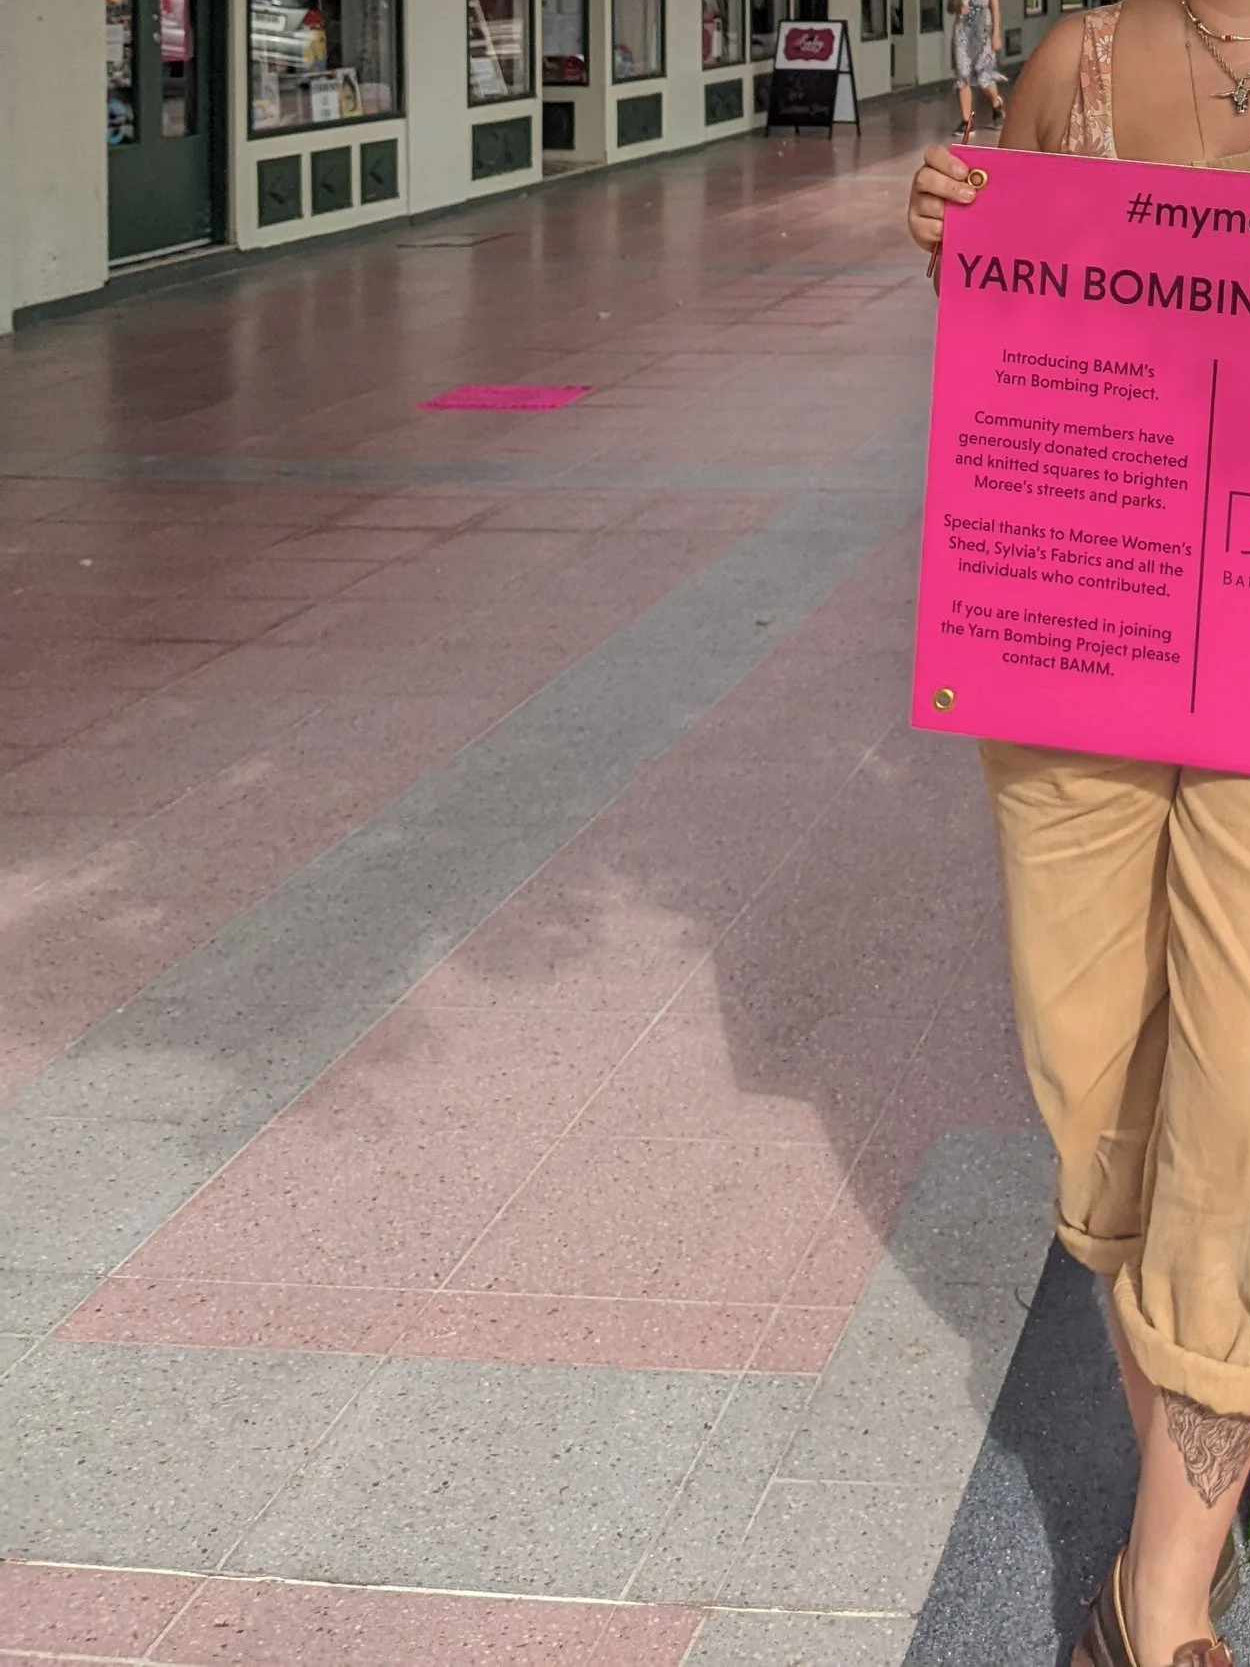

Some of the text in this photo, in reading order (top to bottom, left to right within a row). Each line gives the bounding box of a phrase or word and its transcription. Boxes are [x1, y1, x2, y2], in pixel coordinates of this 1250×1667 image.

[957, 252, 1069, 298] YARN
[1002, 349, 1089, 375] Introducing
[995, 369, 1159, 401] Yarn Bombing Project.
[974, 410, 1175, 446] Community members have
[958, 433, 1188, 469] generously donated crocheted
[955, 453, 1188, 490] and knitted squares to brighten
[1036, 483, 1085, 500] streets
[1089, 490, 1118, 504] and
[1121, 494, 1166, 510] parks.
[943, 513, 995, 532] Special
[998, 520, 1046, 539] thanks
[1049, 527, 1065, 541] to
[1069, 528, 1119, 547] Moree
[948, 535, 990, 555] Shed,
[1051, 548, 1102, 567] Fabrics
[1105, 557, 1134, 571] and
[1138, 559, 1155, 573] all
[1159, 561, 1184, 577] the
[958, 560, 1171, 597] individuals who contributed.
[951, 599, 1172, 644] If you are interested in joining
[940, 620, 1181, 664] the Yarn Bombing Project please
[1002, 652, 1115, 677] contact BAMM.
